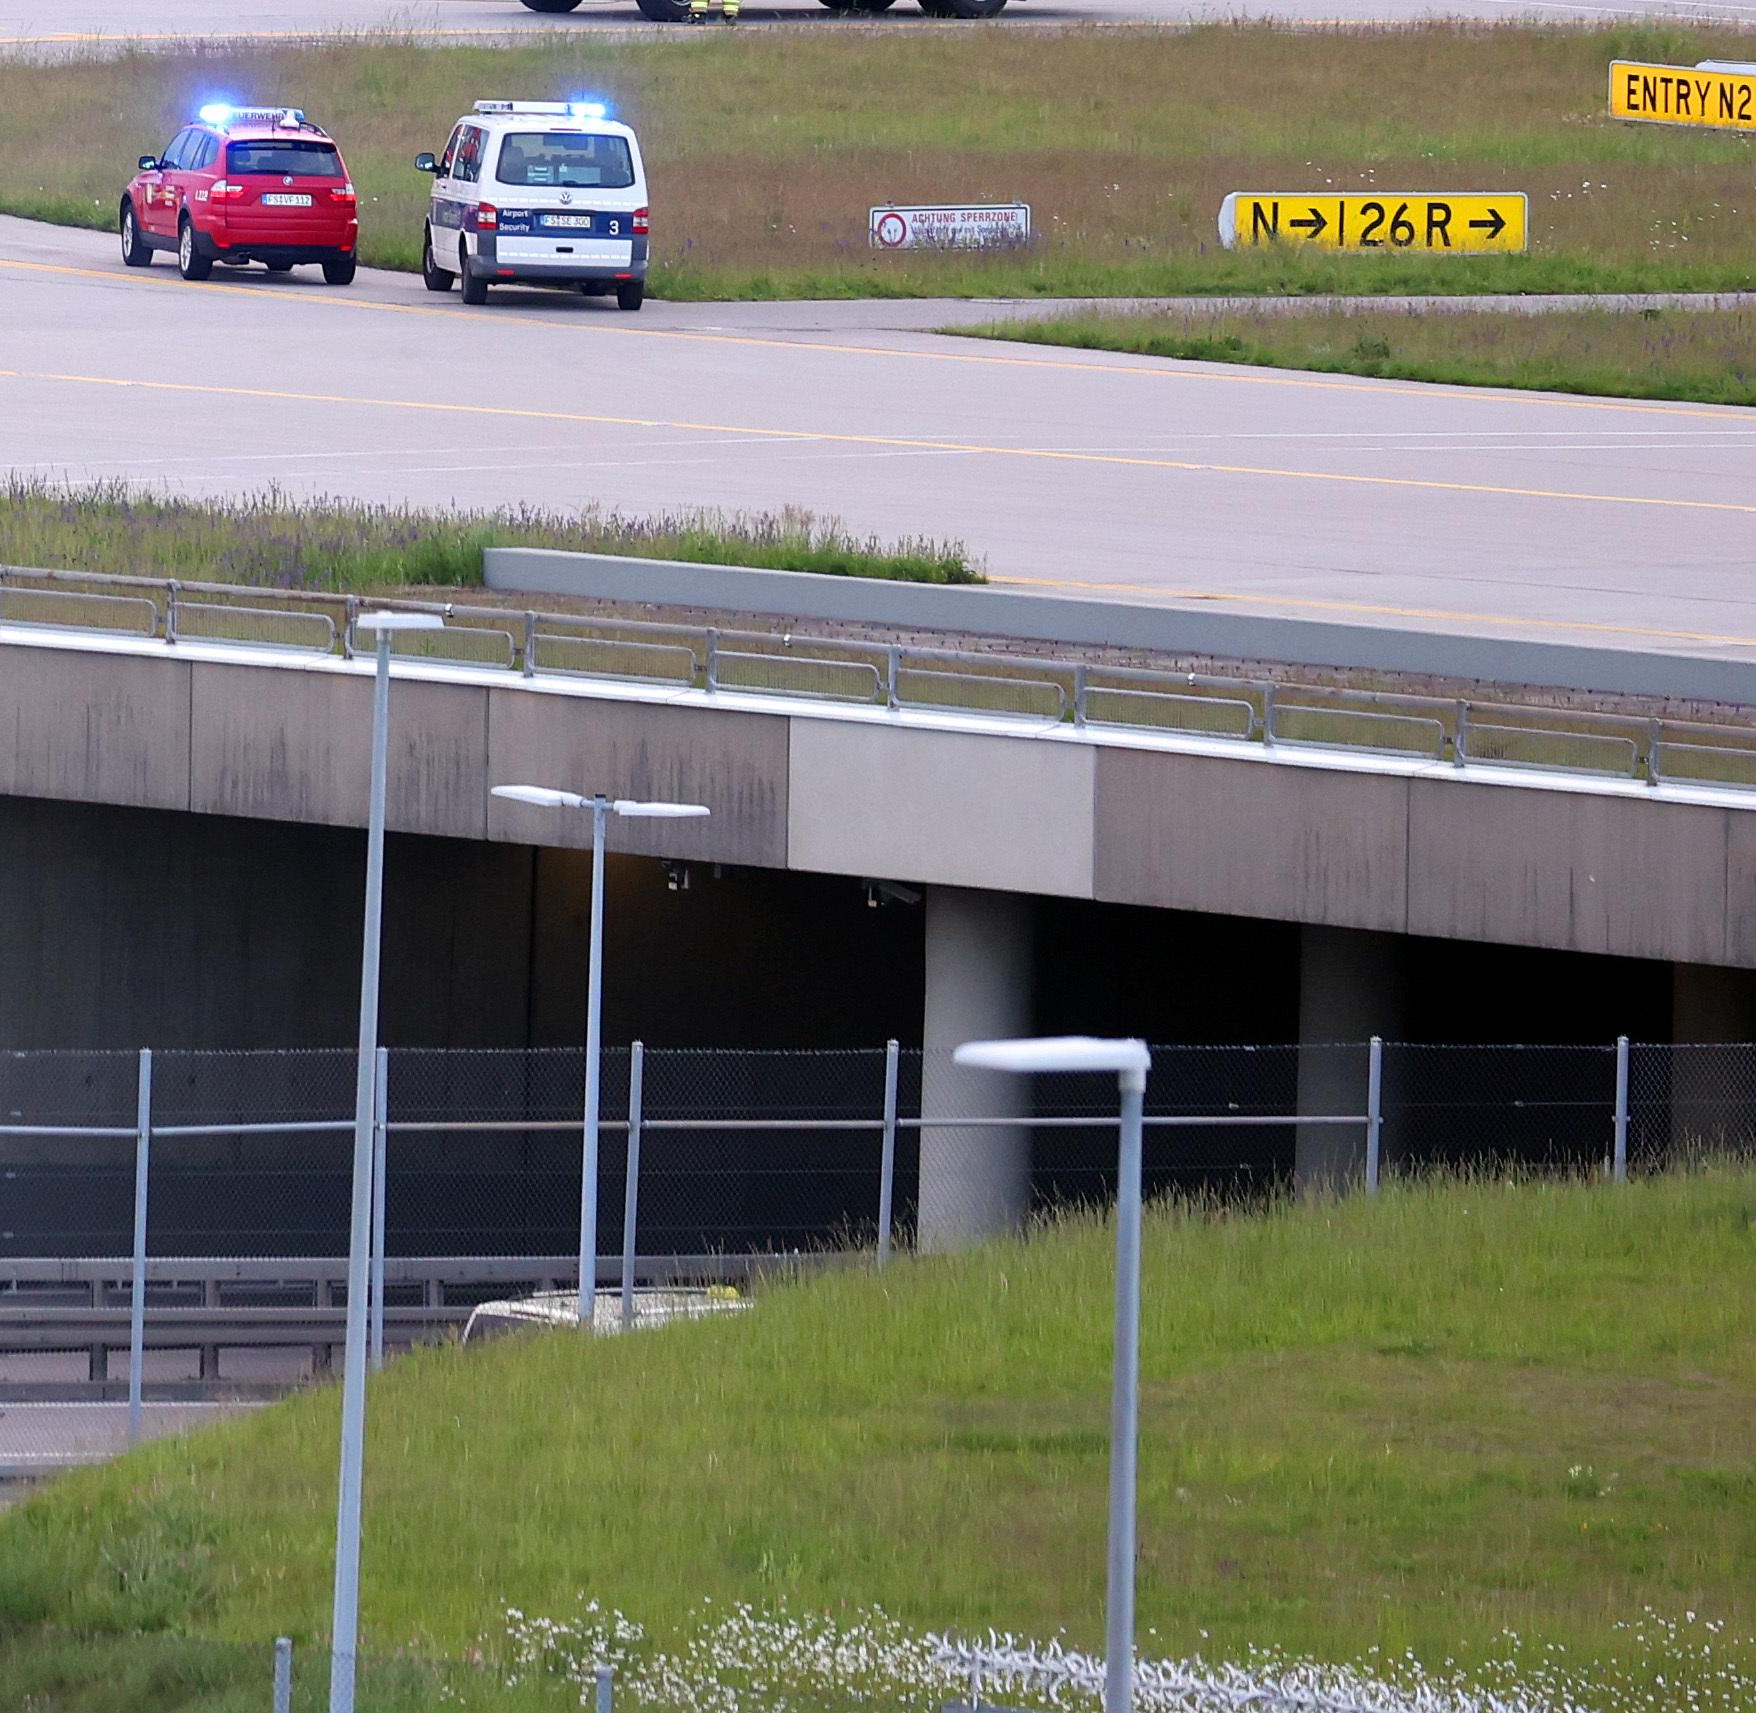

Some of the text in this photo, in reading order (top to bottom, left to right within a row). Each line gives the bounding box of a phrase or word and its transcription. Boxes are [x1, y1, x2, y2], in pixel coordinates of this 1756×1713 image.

[1627, 74, 1752, 121] ENTRY N2
[502, 209, 529, 220] Airport
[911, 211, 1017, 224] ACHTUNG SPERRZONE
[499, 222, 530, 233] Security
[608, 220, 620, 236] 3
[1252, 202, 1279, 246] N
